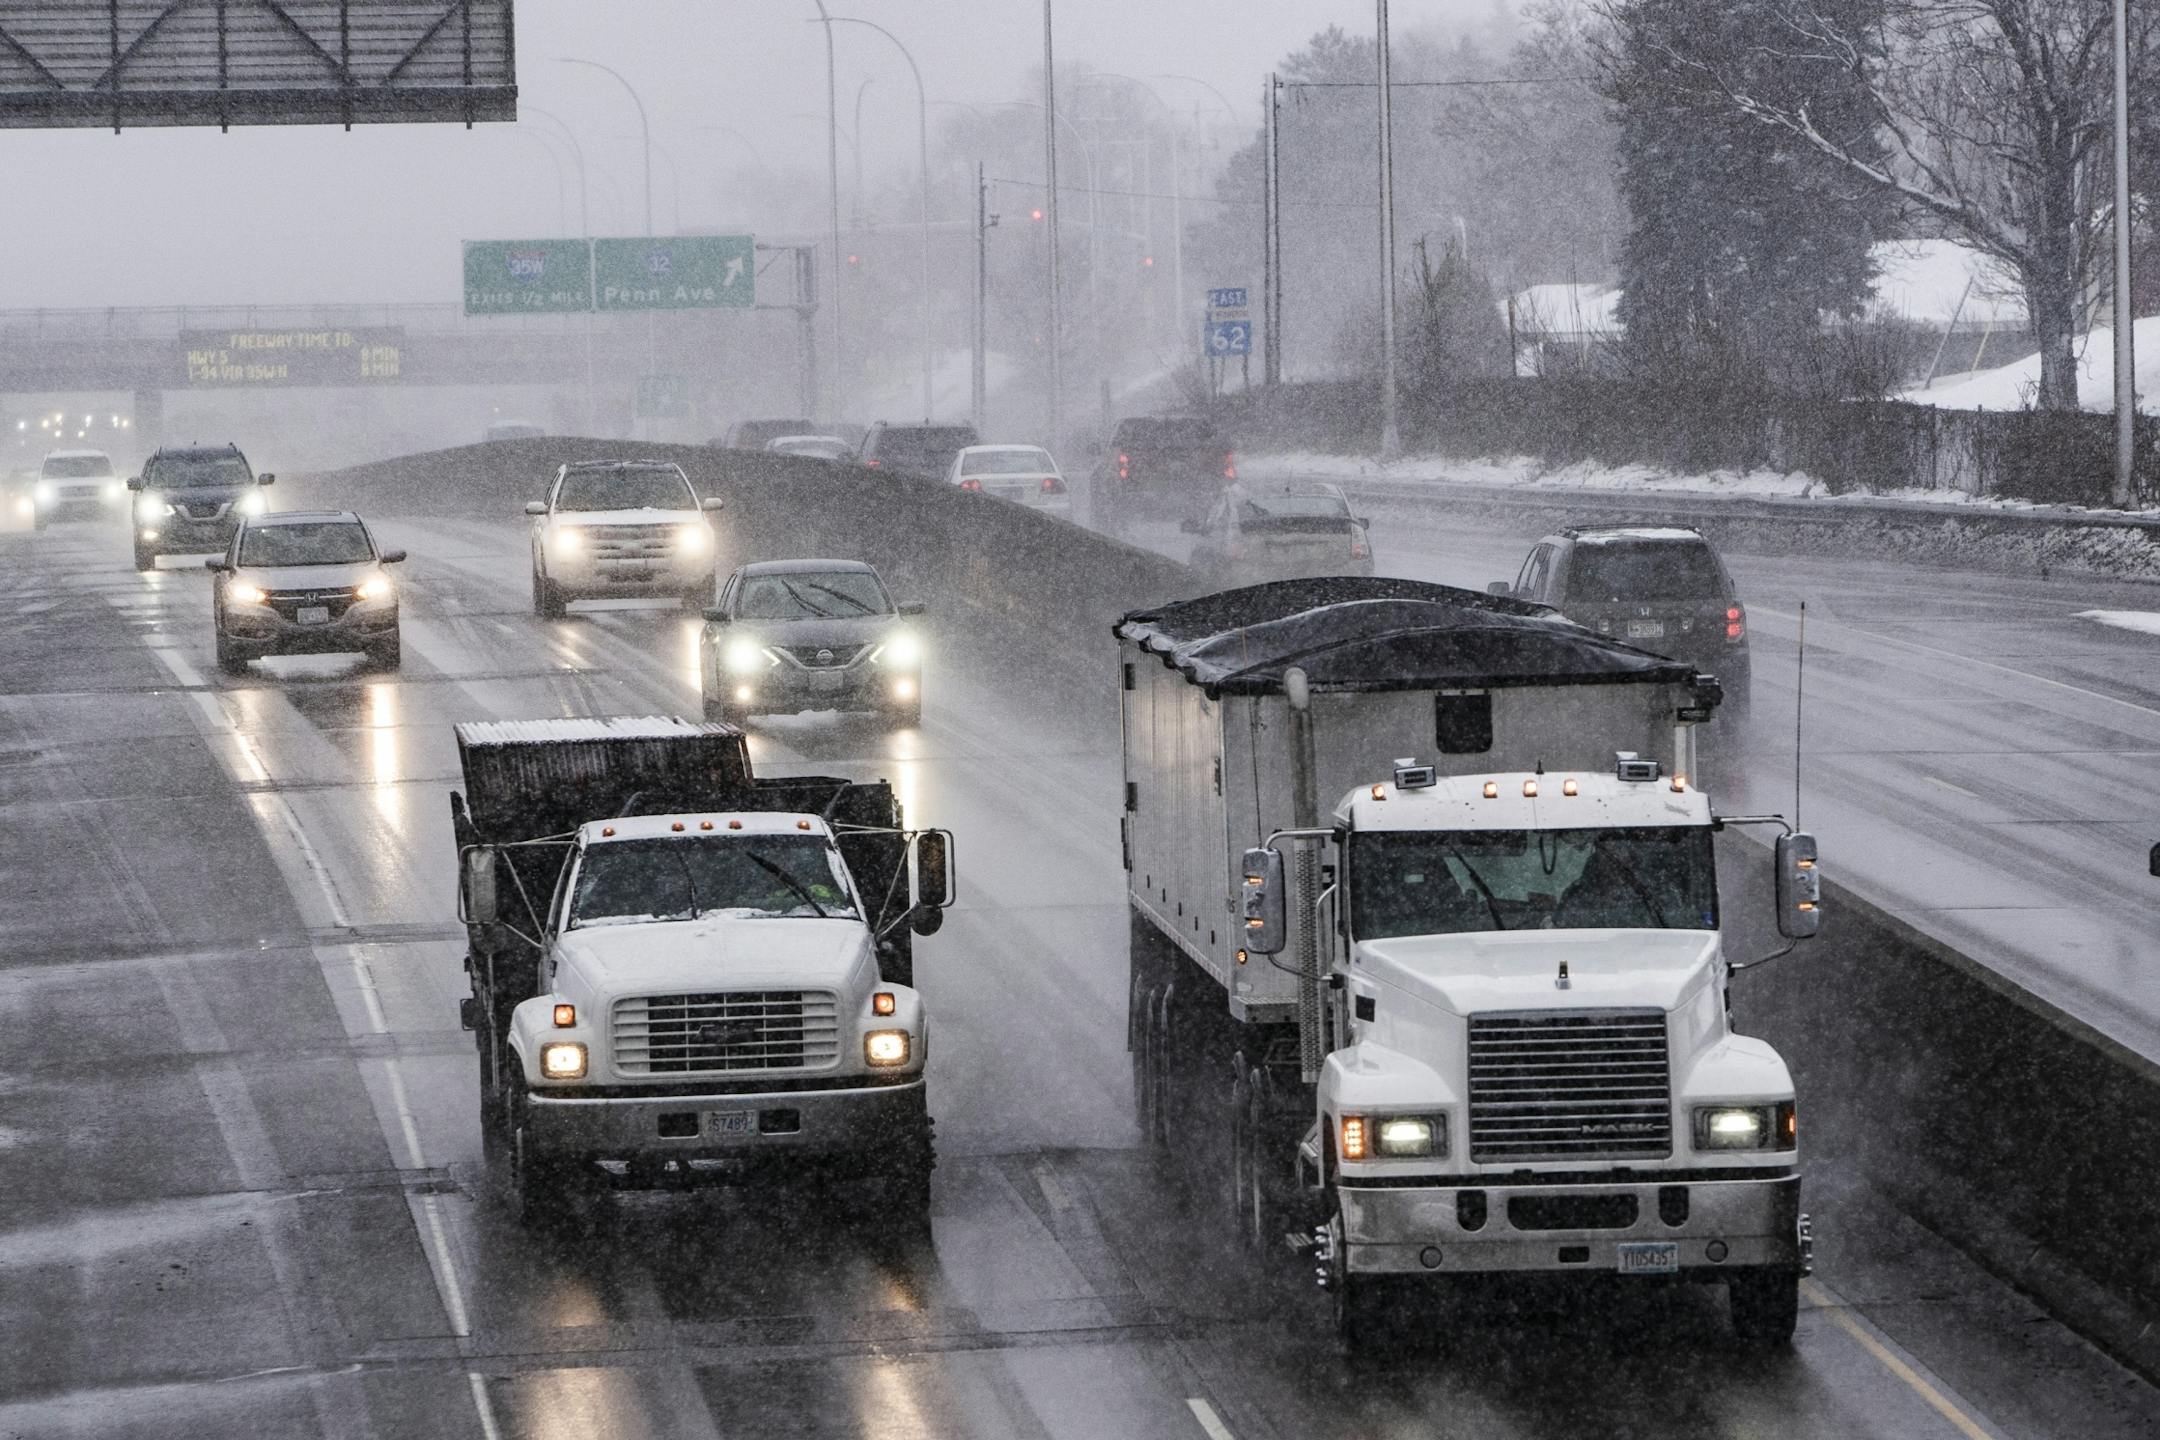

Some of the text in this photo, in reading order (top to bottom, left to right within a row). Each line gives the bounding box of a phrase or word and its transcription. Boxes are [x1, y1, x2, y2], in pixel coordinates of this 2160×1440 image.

[604, 284, 715, 302] Penn Ave
[1208, 291, 1242, 305] EAST
[231, 331, 352, 349] FREEWAY TIME TO
[1213, 326, 1245, 351] 62
[1581, 1122, 1654, 1135] MACK
